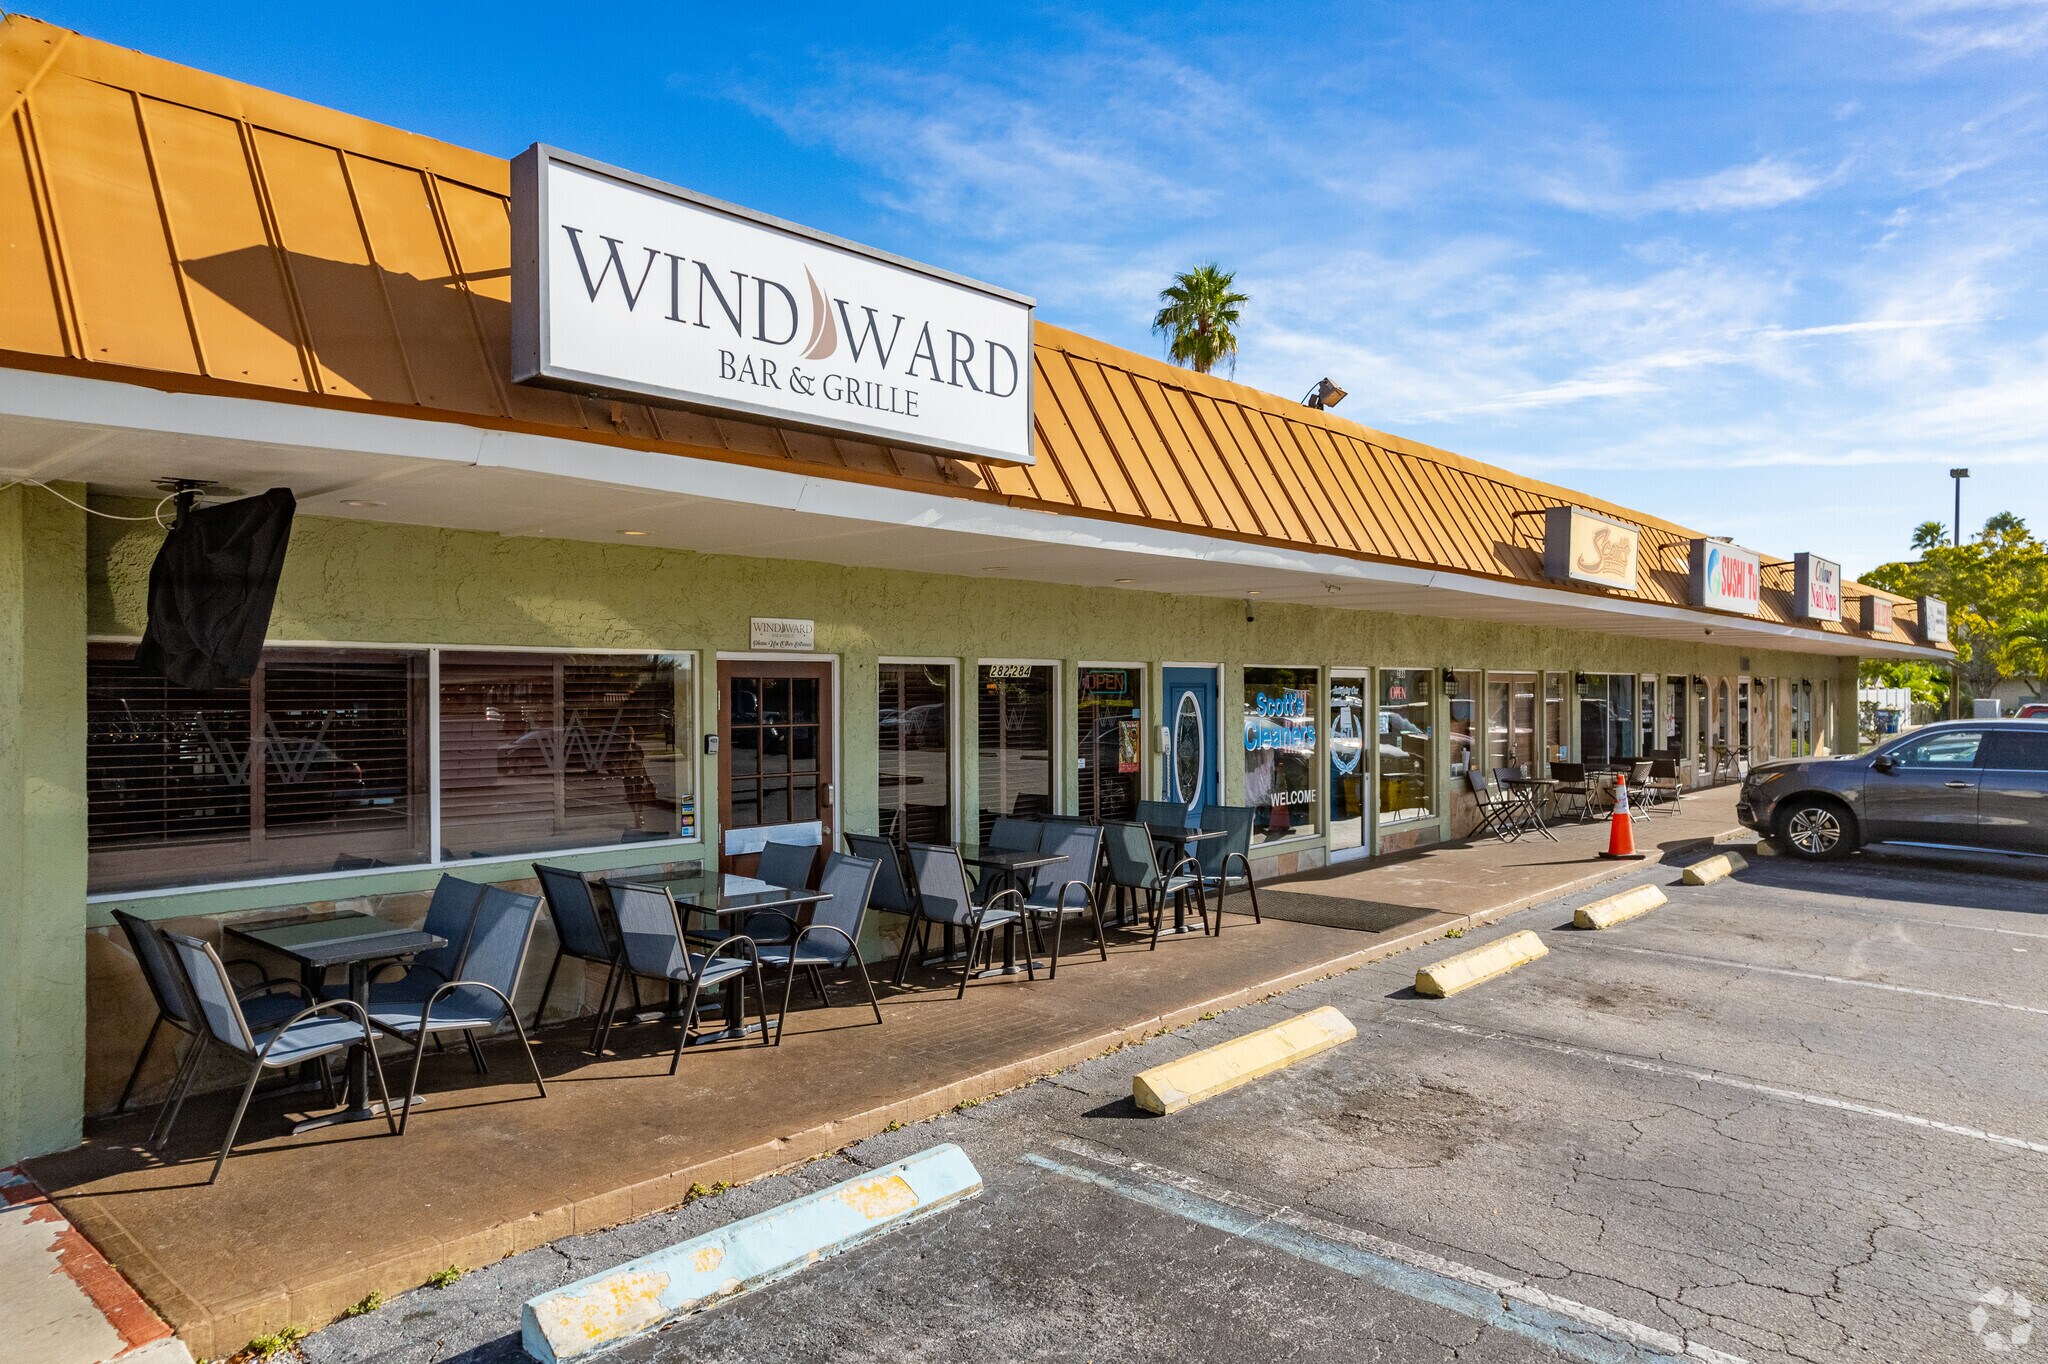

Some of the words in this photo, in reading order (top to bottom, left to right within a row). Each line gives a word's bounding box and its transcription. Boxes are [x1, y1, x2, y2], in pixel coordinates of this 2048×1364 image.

[718, 349, 782, 390] BAR
[789, 366, 816, 397] &
[823, 374, 919, 418] GRILLE
[1721, 555, 1746, 598] SUSHI
[1811, 582, 1824, 609] Nail
[1825, 586, 1837, 618] Spa
[753, 622, 813, 633] WINDWARD
[1085, 673, 1124, 689] OPEN
[1390, 686, 1407, 699] OPEN
[1256, 691, 1304, 717] Scott's
[1244, 720, 1316, 751] Cleaners
[1271, 789, 1317, 807] WELCOME
